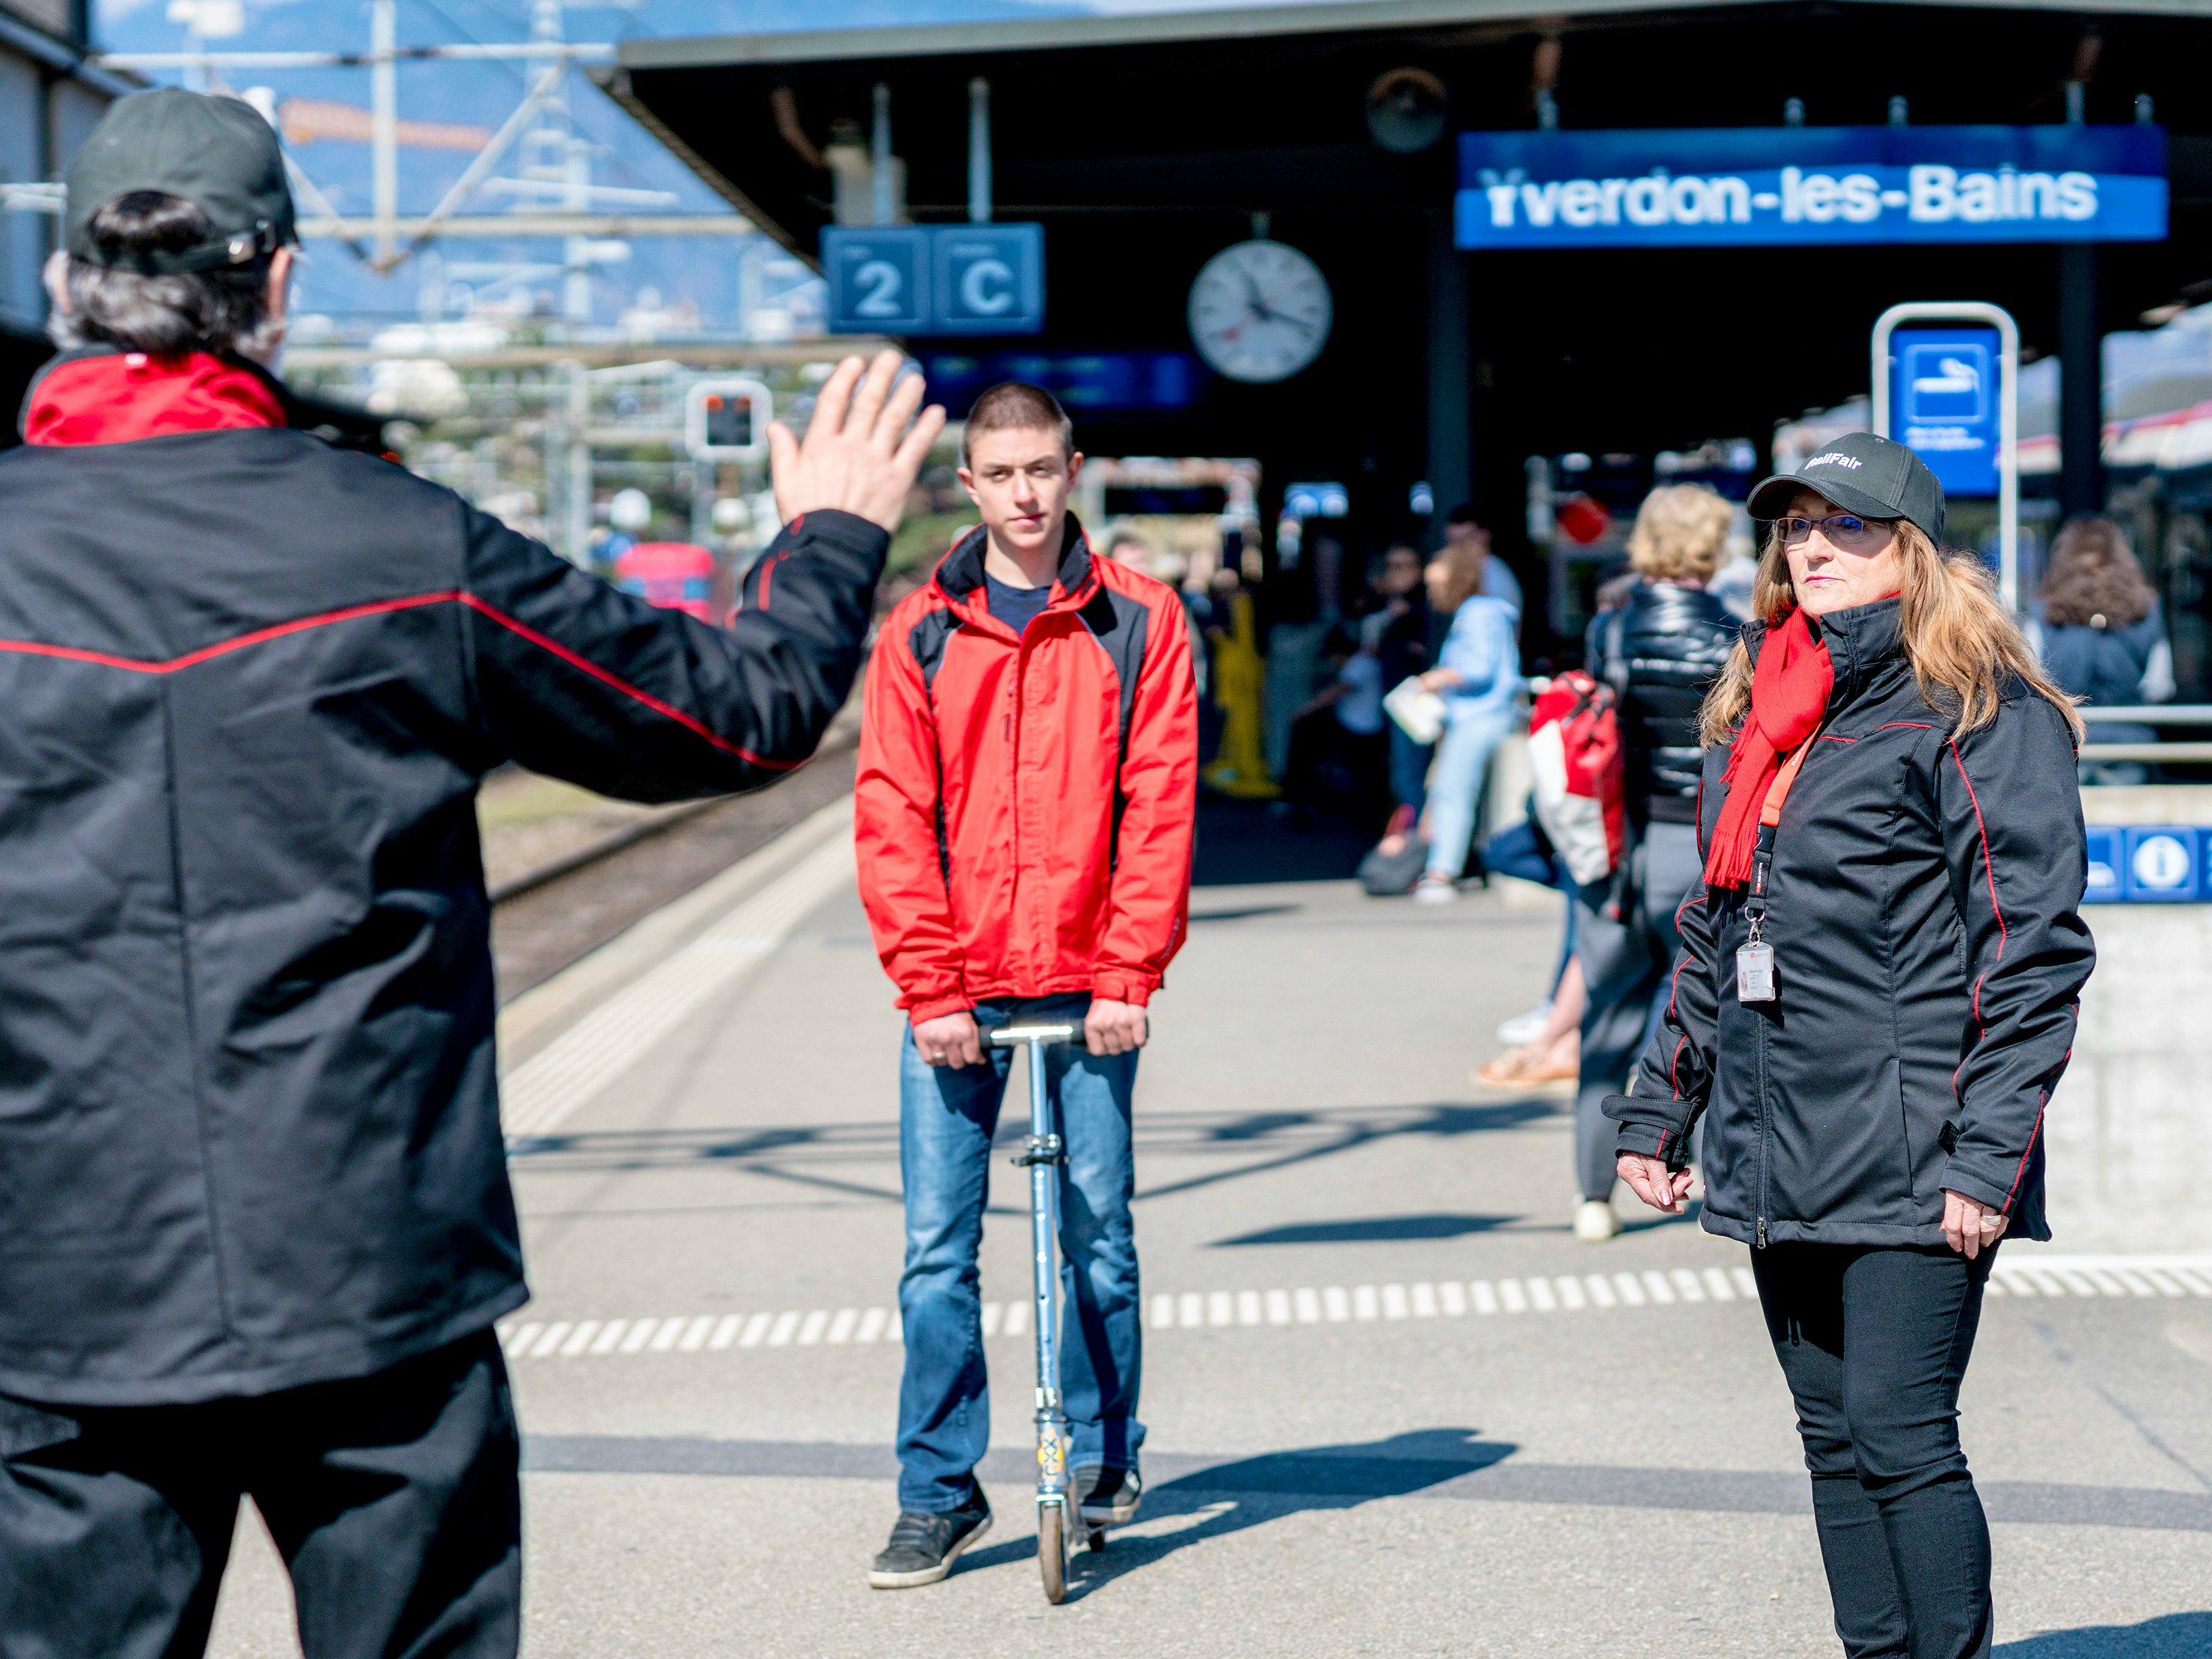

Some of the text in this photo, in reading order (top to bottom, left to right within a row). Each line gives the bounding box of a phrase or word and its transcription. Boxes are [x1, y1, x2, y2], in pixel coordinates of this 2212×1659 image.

[1477, 163, 2099, 228] Yverdon-les-Bains
[854, 259, 1015, 317] 2 C
